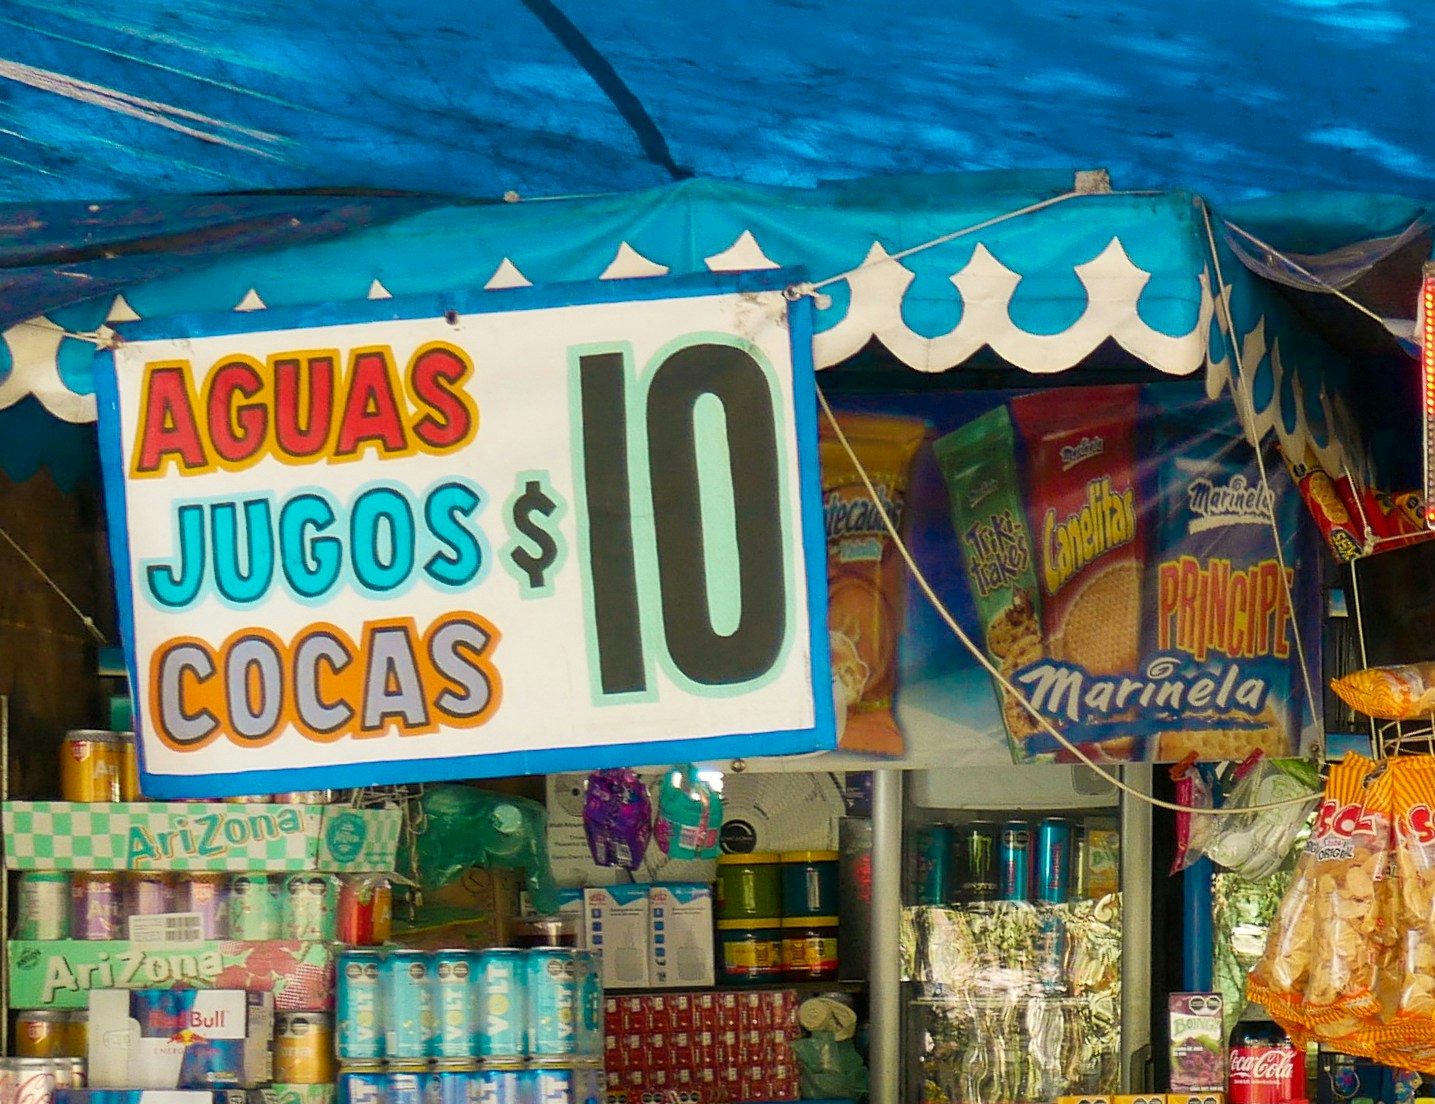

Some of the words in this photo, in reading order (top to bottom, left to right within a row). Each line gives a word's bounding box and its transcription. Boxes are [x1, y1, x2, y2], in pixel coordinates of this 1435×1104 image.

[133, 343, 476, 476] AGUAS
[1188, 475, 1275, 517] Marinela
[144, 480, 485, 610] JUGOS
[969, 535, 1029, 598] trakes
[1043, 475, 1135, 595] Canelitas
[156, 620, 500, 748] COCAS
[1019, 657, 1266, 721] Marinela
[127, 807, 304, 869] AriZona
[1316, 802, 1375, 839] SOL
[42, 949, 224, 1004] AriZona
[487, 960, 510, 1036] VOLT
[189, 1010, 225, 1028] Bull
